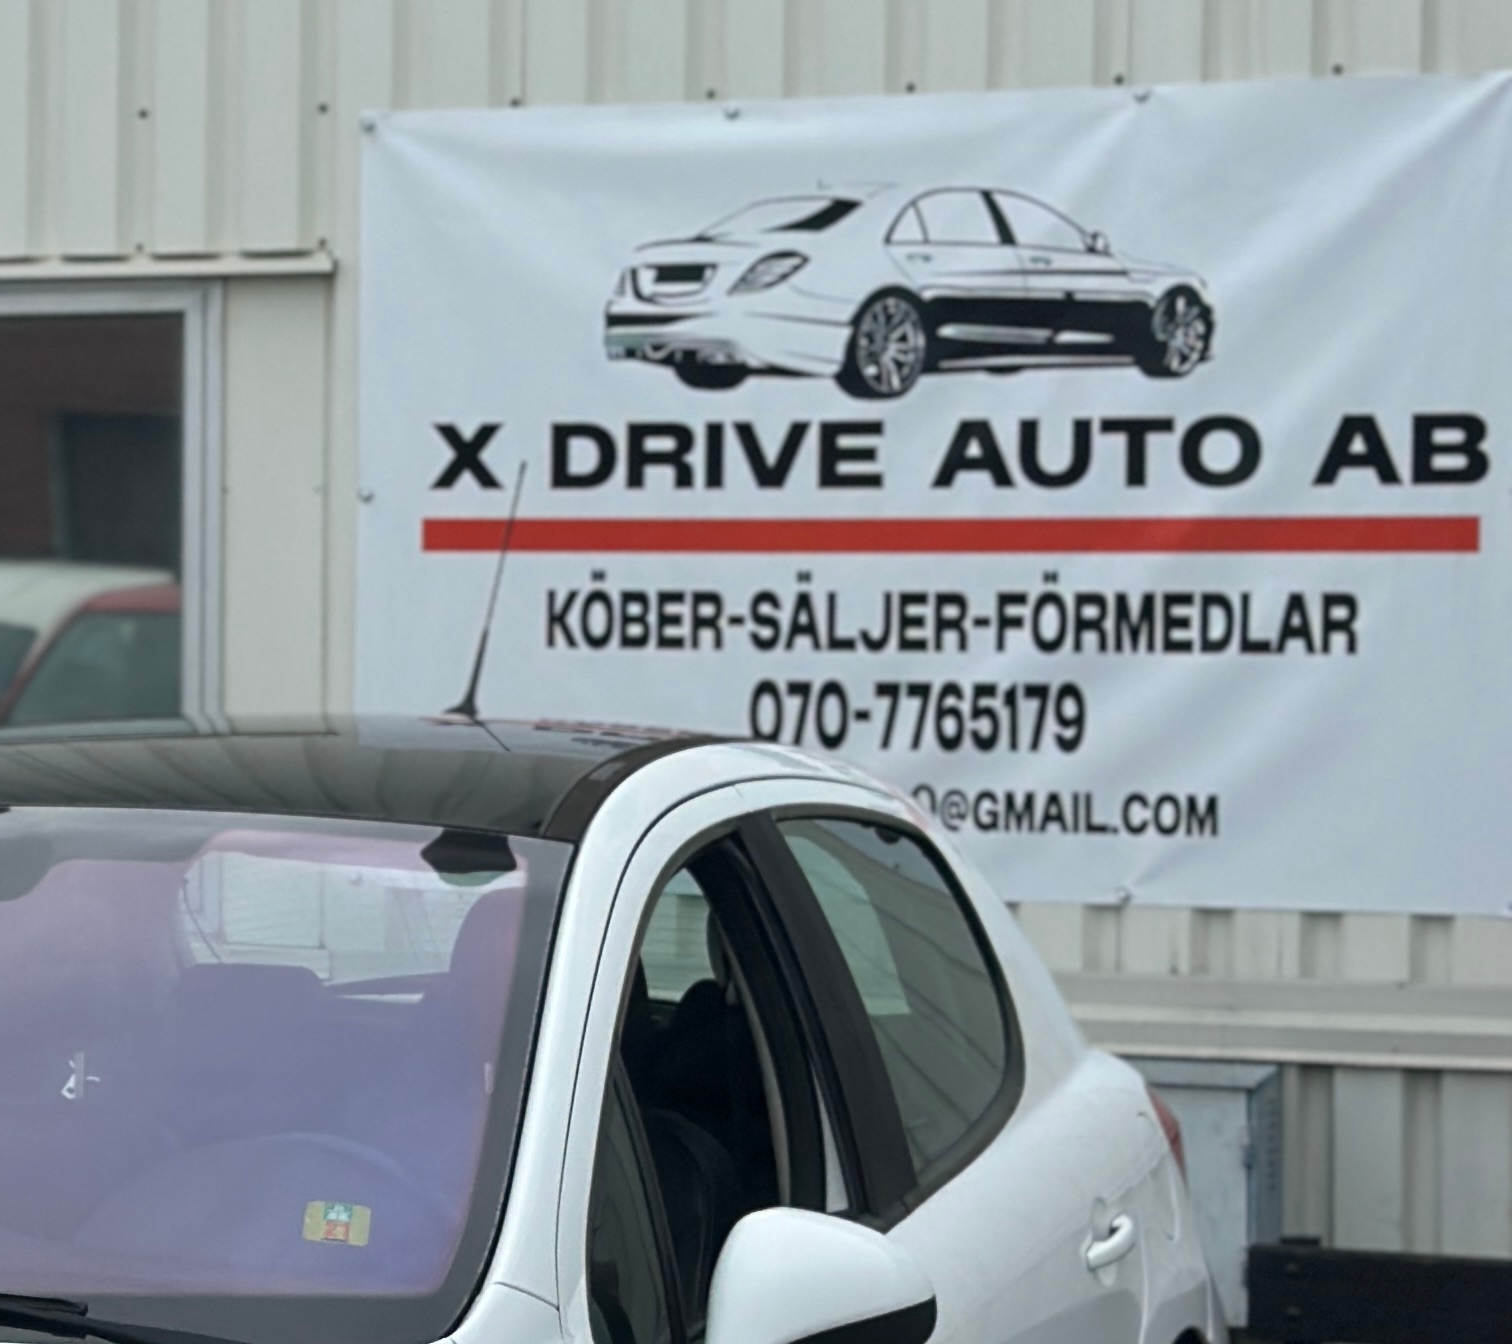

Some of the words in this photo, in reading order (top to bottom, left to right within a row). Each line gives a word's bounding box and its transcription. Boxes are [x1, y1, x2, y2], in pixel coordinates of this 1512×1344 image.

[431, 423, 503, 489] X
[550, 420, 885, 489] DRIVE
[931, 415, 1263, 489] AUTO
[1312, 413, 1490, 487] AB
[546, 570, 1359, 655] KÖBER-SÄLJER-FÖRMEDLAR
[748, 678, 1087, 754] 070-7765179
